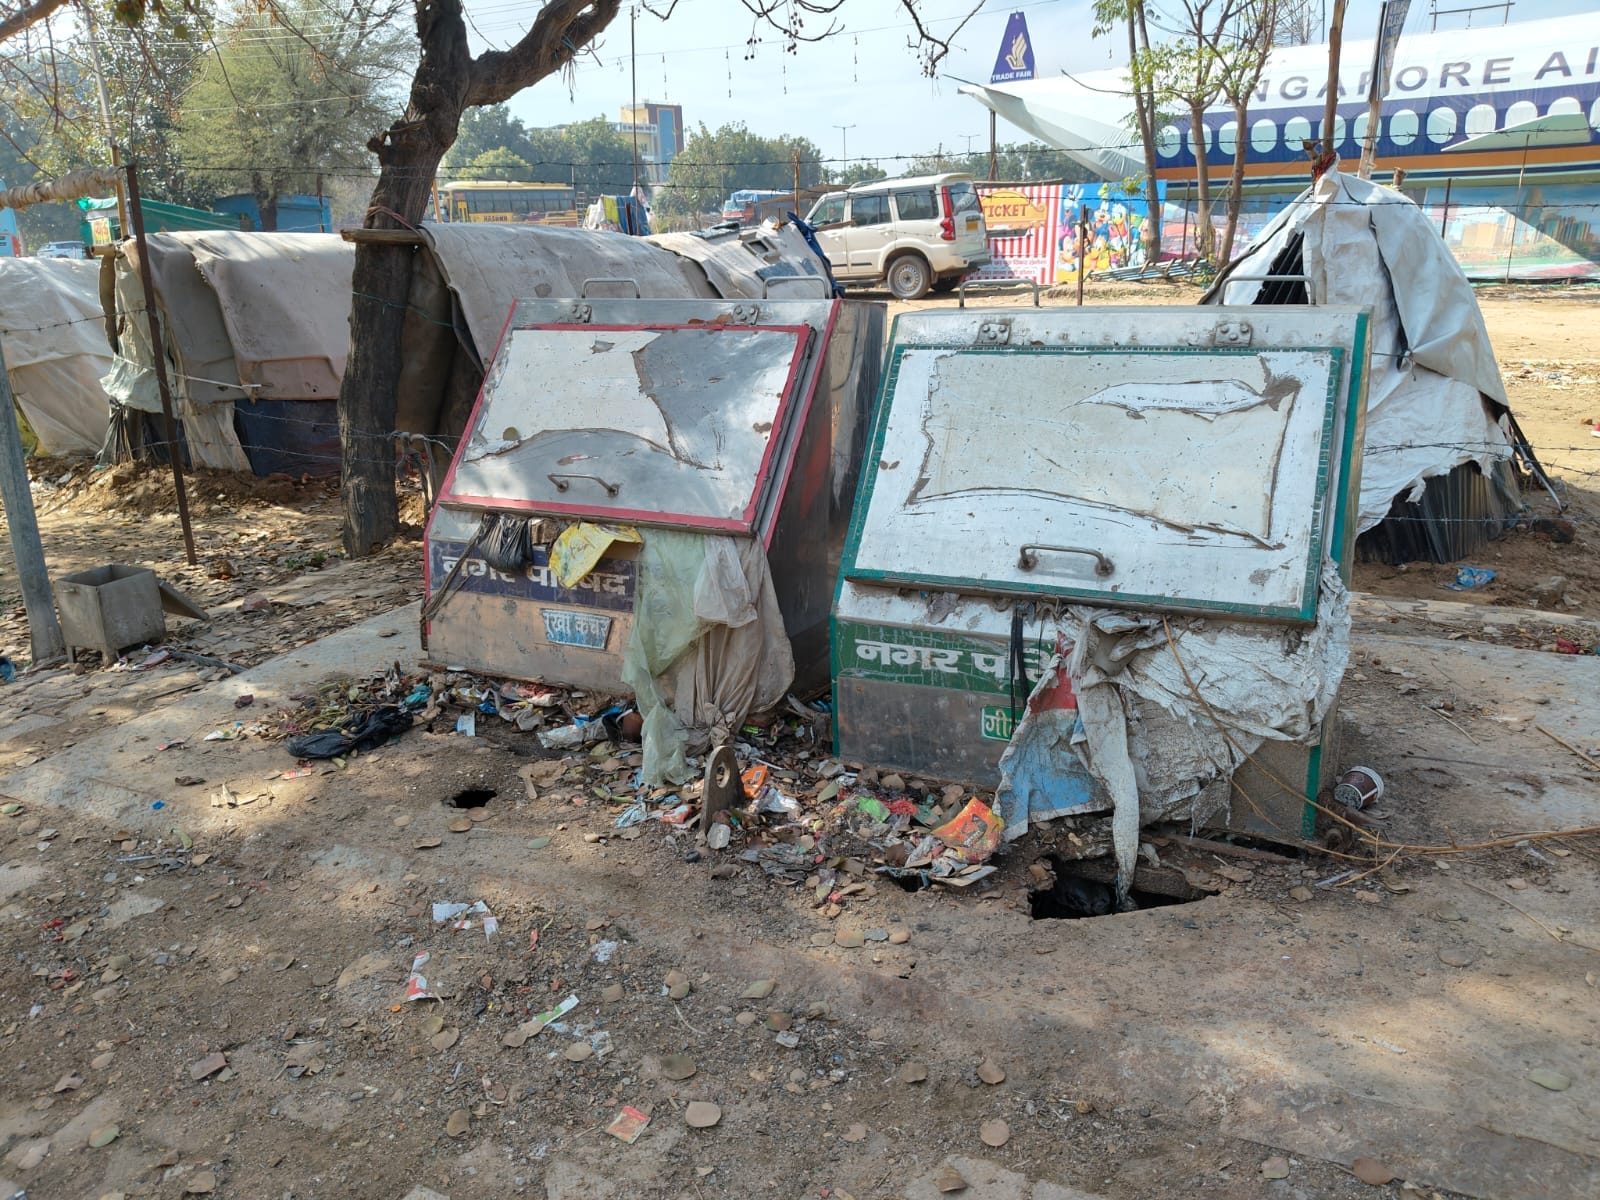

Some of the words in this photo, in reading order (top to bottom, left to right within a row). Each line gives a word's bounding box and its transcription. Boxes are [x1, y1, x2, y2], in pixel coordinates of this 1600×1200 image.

[992, 72, 1015, 81] TRADE
[1016, 70, 1032, 78] FAIR
[855, 638, 964, 674] नगर
